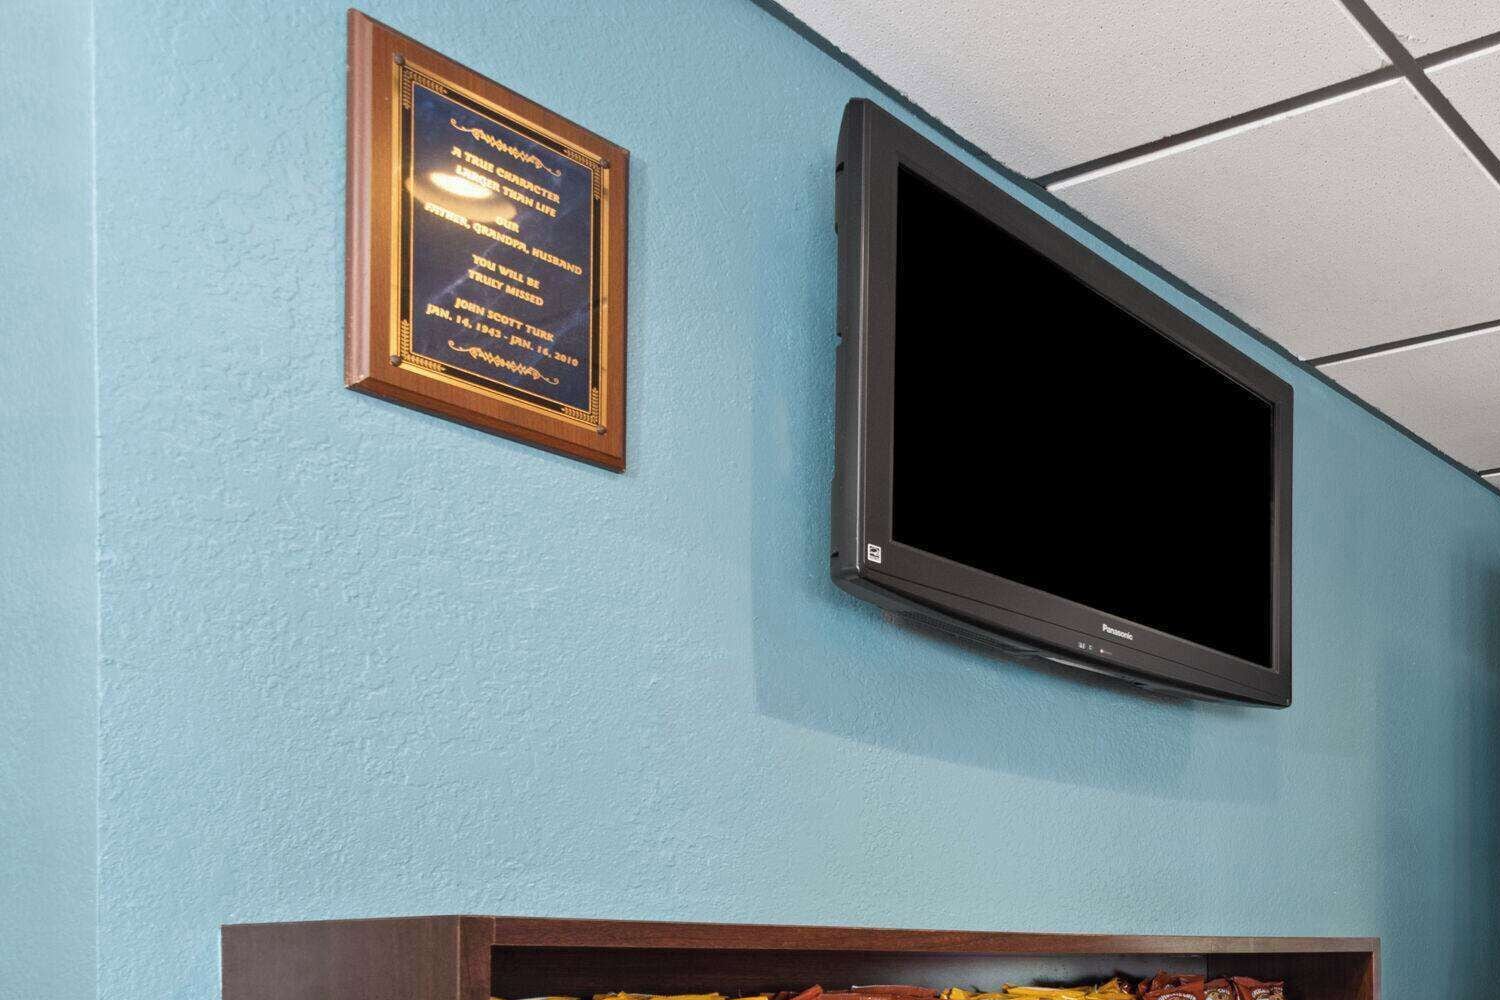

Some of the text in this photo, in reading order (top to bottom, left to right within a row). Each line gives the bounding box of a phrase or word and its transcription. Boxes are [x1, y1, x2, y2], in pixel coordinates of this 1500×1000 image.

[450, 145, 561, 204] A TRUE CHARACTER
[502, 185, 534, 208] THAN
[535, 200, 558, 218] LIFE
[495, 215, 520, 233] OUR
[472, 222, 530, 254] GRANDPA,
[531, 247, 583, 276] HUSBAND
[467, 269, 545, 307] TRULY MISSED
[471, 253, 542, 290] YOU WILL BE
[454, 297, 555, 343] JOHN SCOTT TURK
[1102, 623, 1133, 641] Panasonic
